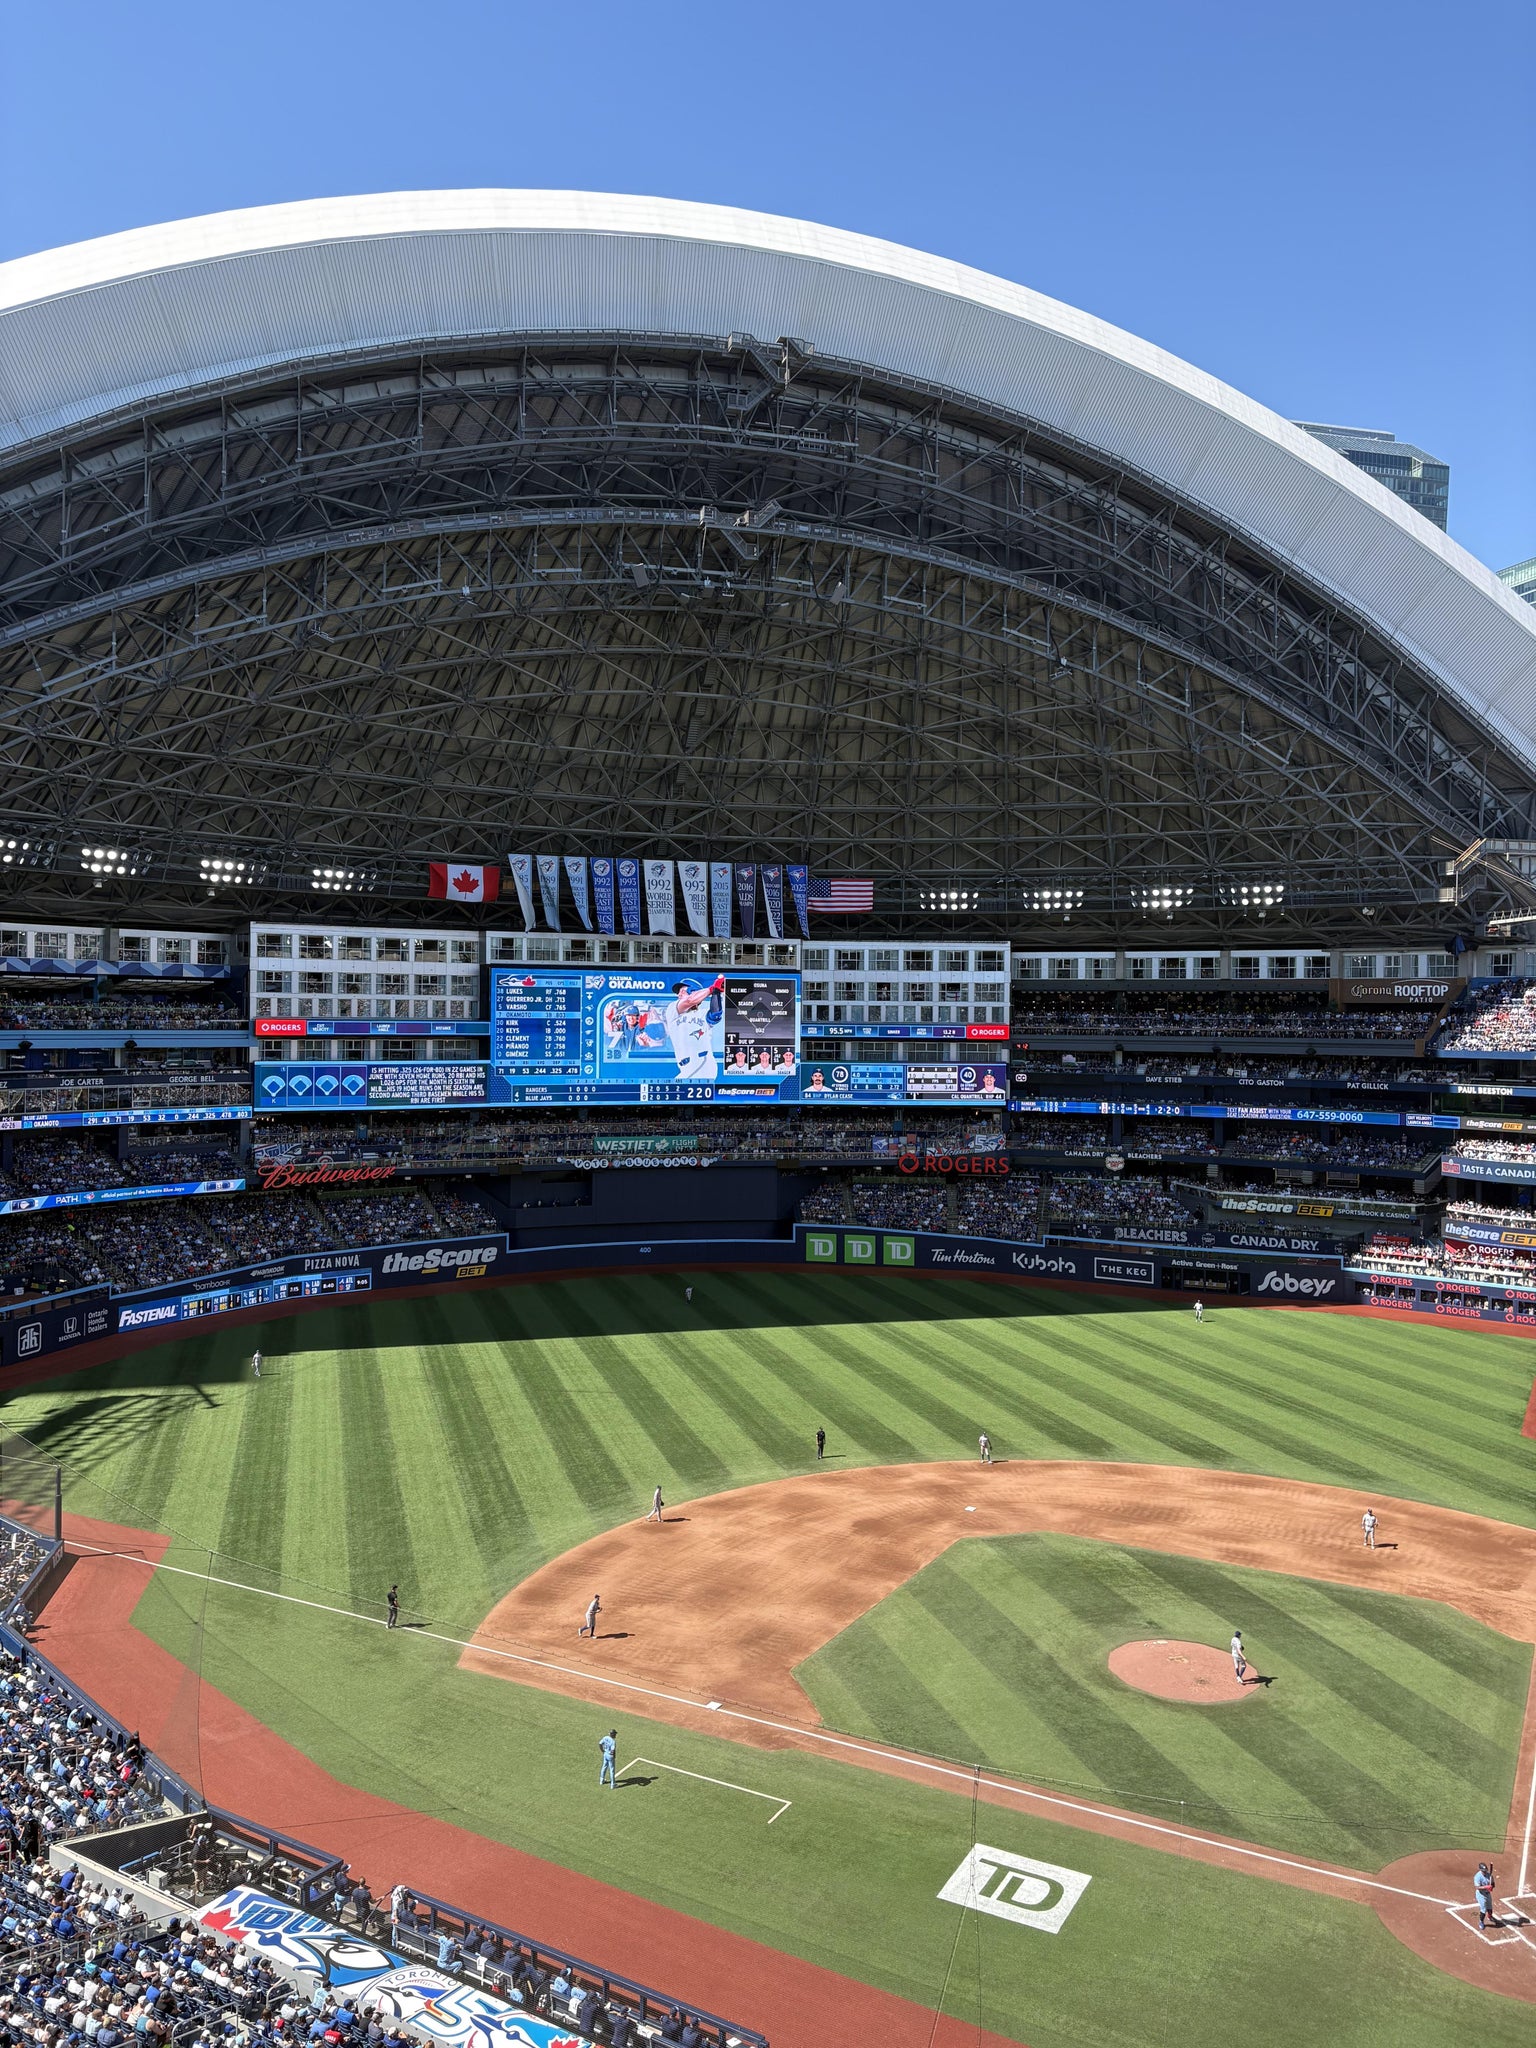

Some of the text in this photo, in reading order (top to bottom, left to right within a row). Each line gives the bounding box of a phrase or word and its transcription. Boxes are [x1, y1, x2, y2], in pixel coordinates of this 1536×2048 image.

[594, 878, 610, 886] 1992
[620, 878, 636, 886] 1993
[647, 879, 671, 890] 1992
[738, 882, 753, 890] 2016
[608, 981, 665, 990] OKAMOTO
[1352, 984, 1448, 998] Corona ROOFTOP
[728, 1034, 736, 1043] T
[607, 1050, 621, 1059] 3B
[1478, 1087, 1513, 1095] BEESTON
[1297, 1111, 1363, 1122] 647-559-0060
[597, 1140, 654, 1151] WESTJET
[575, 1156, 697, 1169] VOTE BLUE JAYS
[925, 1156, 1009, 1174] ROGERS
[258, 1162, 396, 1189] Budweiser
[1462, 1165, 1484, 1174] TASTE
[1486, 1167, 1492, 1175] A
[1495, 1169, 1536, 1178] CANADI
[56, 1196, 78, 1204] PATH
[1222, 1199, 1293, 1213] theScore
[1299, 1205, 1333, 1215] BET
[1114, 1228, 1187, 1242] BLEACHERS
[1445, 1224, 1536, 1244] theScore BET
[810, 1239, 834, 1256] TD
[1230, 1235, 1320, 1251] CANADA DRY.
[848, 1241, 872, 1258] TD
[887, 1242, 911, 1260] TD
[382, 1247, 498, 1273] theScore
[932, 1249, 995, 1265] Tim Hortons
[305, 1255, 360, 1271] PIZZA NOVA
[1012, 1252, 1076, 1274] Kubota
[1171, 1259, 1193, 1267] Active
[460, 1266, 485, 1276] BET
[1102, 1265, 1147, 1276] THE KEG
[1258, 1271, 1335, 1296] Sobeys
[1380, 1276, 1413, 1286] ROGERS
[1446, 1284, 1480, 1294] ROGERS
[1380, 1299, 1413, 1309] ROGERS
[88, 1309, 108, 1319] Ontario
[119, 1306, 177, 1327] FASTENAL
[1446, 1308, 1480, 1317] ROGERS
[88, 1317, 105, 1326] Honda
[88, 1323, 108, 1333] Dealers
[58, 1332, 82, 1342] HONDA
[979, 1858, 1064, 1912] TD
[385, 1970, 459, 1986] TORONTO
